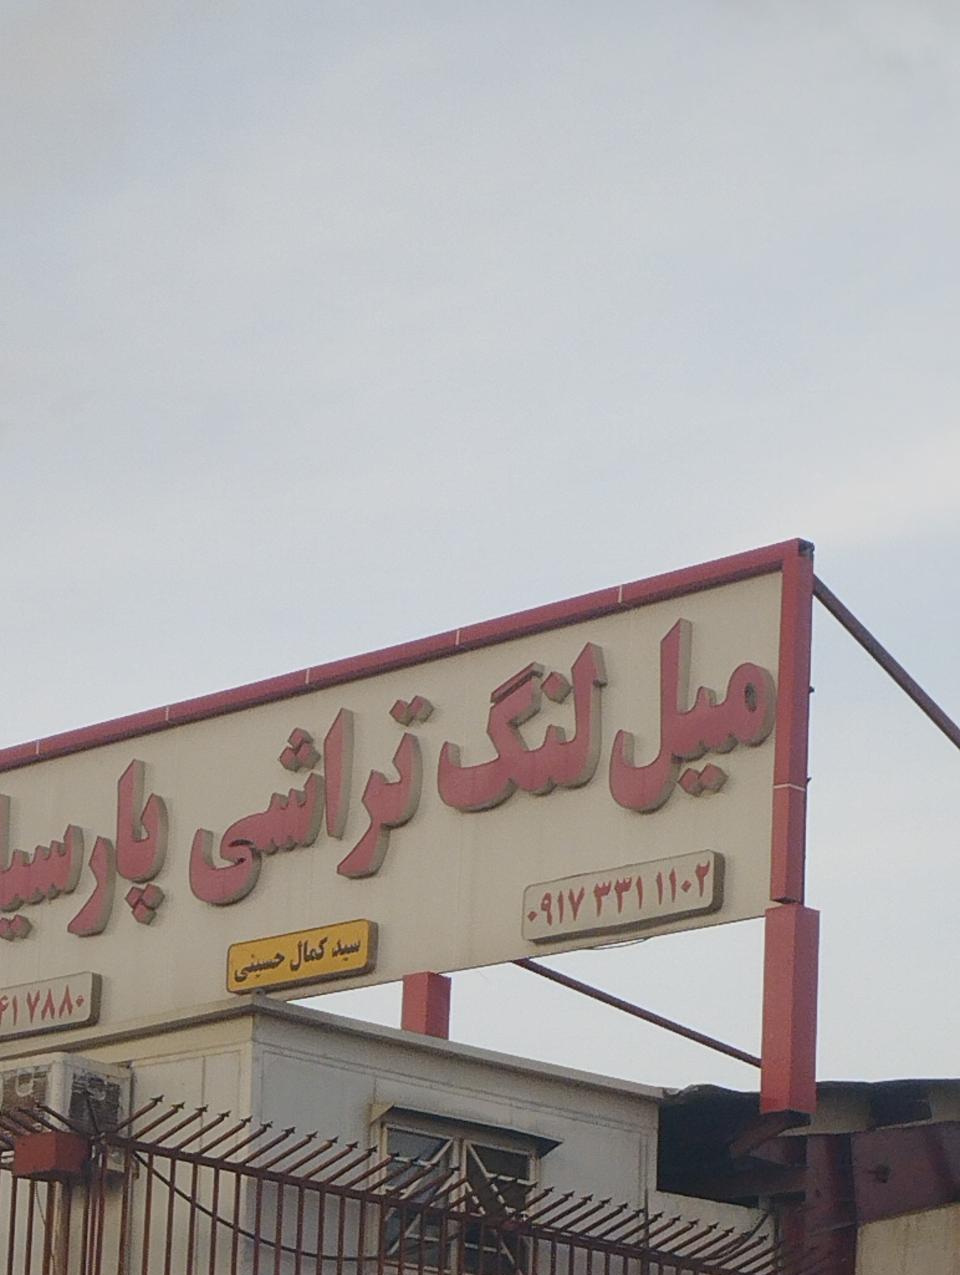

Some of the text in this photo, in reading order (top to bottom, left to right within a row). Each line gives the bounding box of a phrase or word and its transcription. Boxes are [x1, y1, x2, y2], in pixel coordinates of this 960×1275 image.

[189, 695, 435, 906] تراشی
[438, 640, 608, 812] لنگ
[609, 618, 776, 815] میل
[233, 936, 362, 983] سید کمال حسینی
